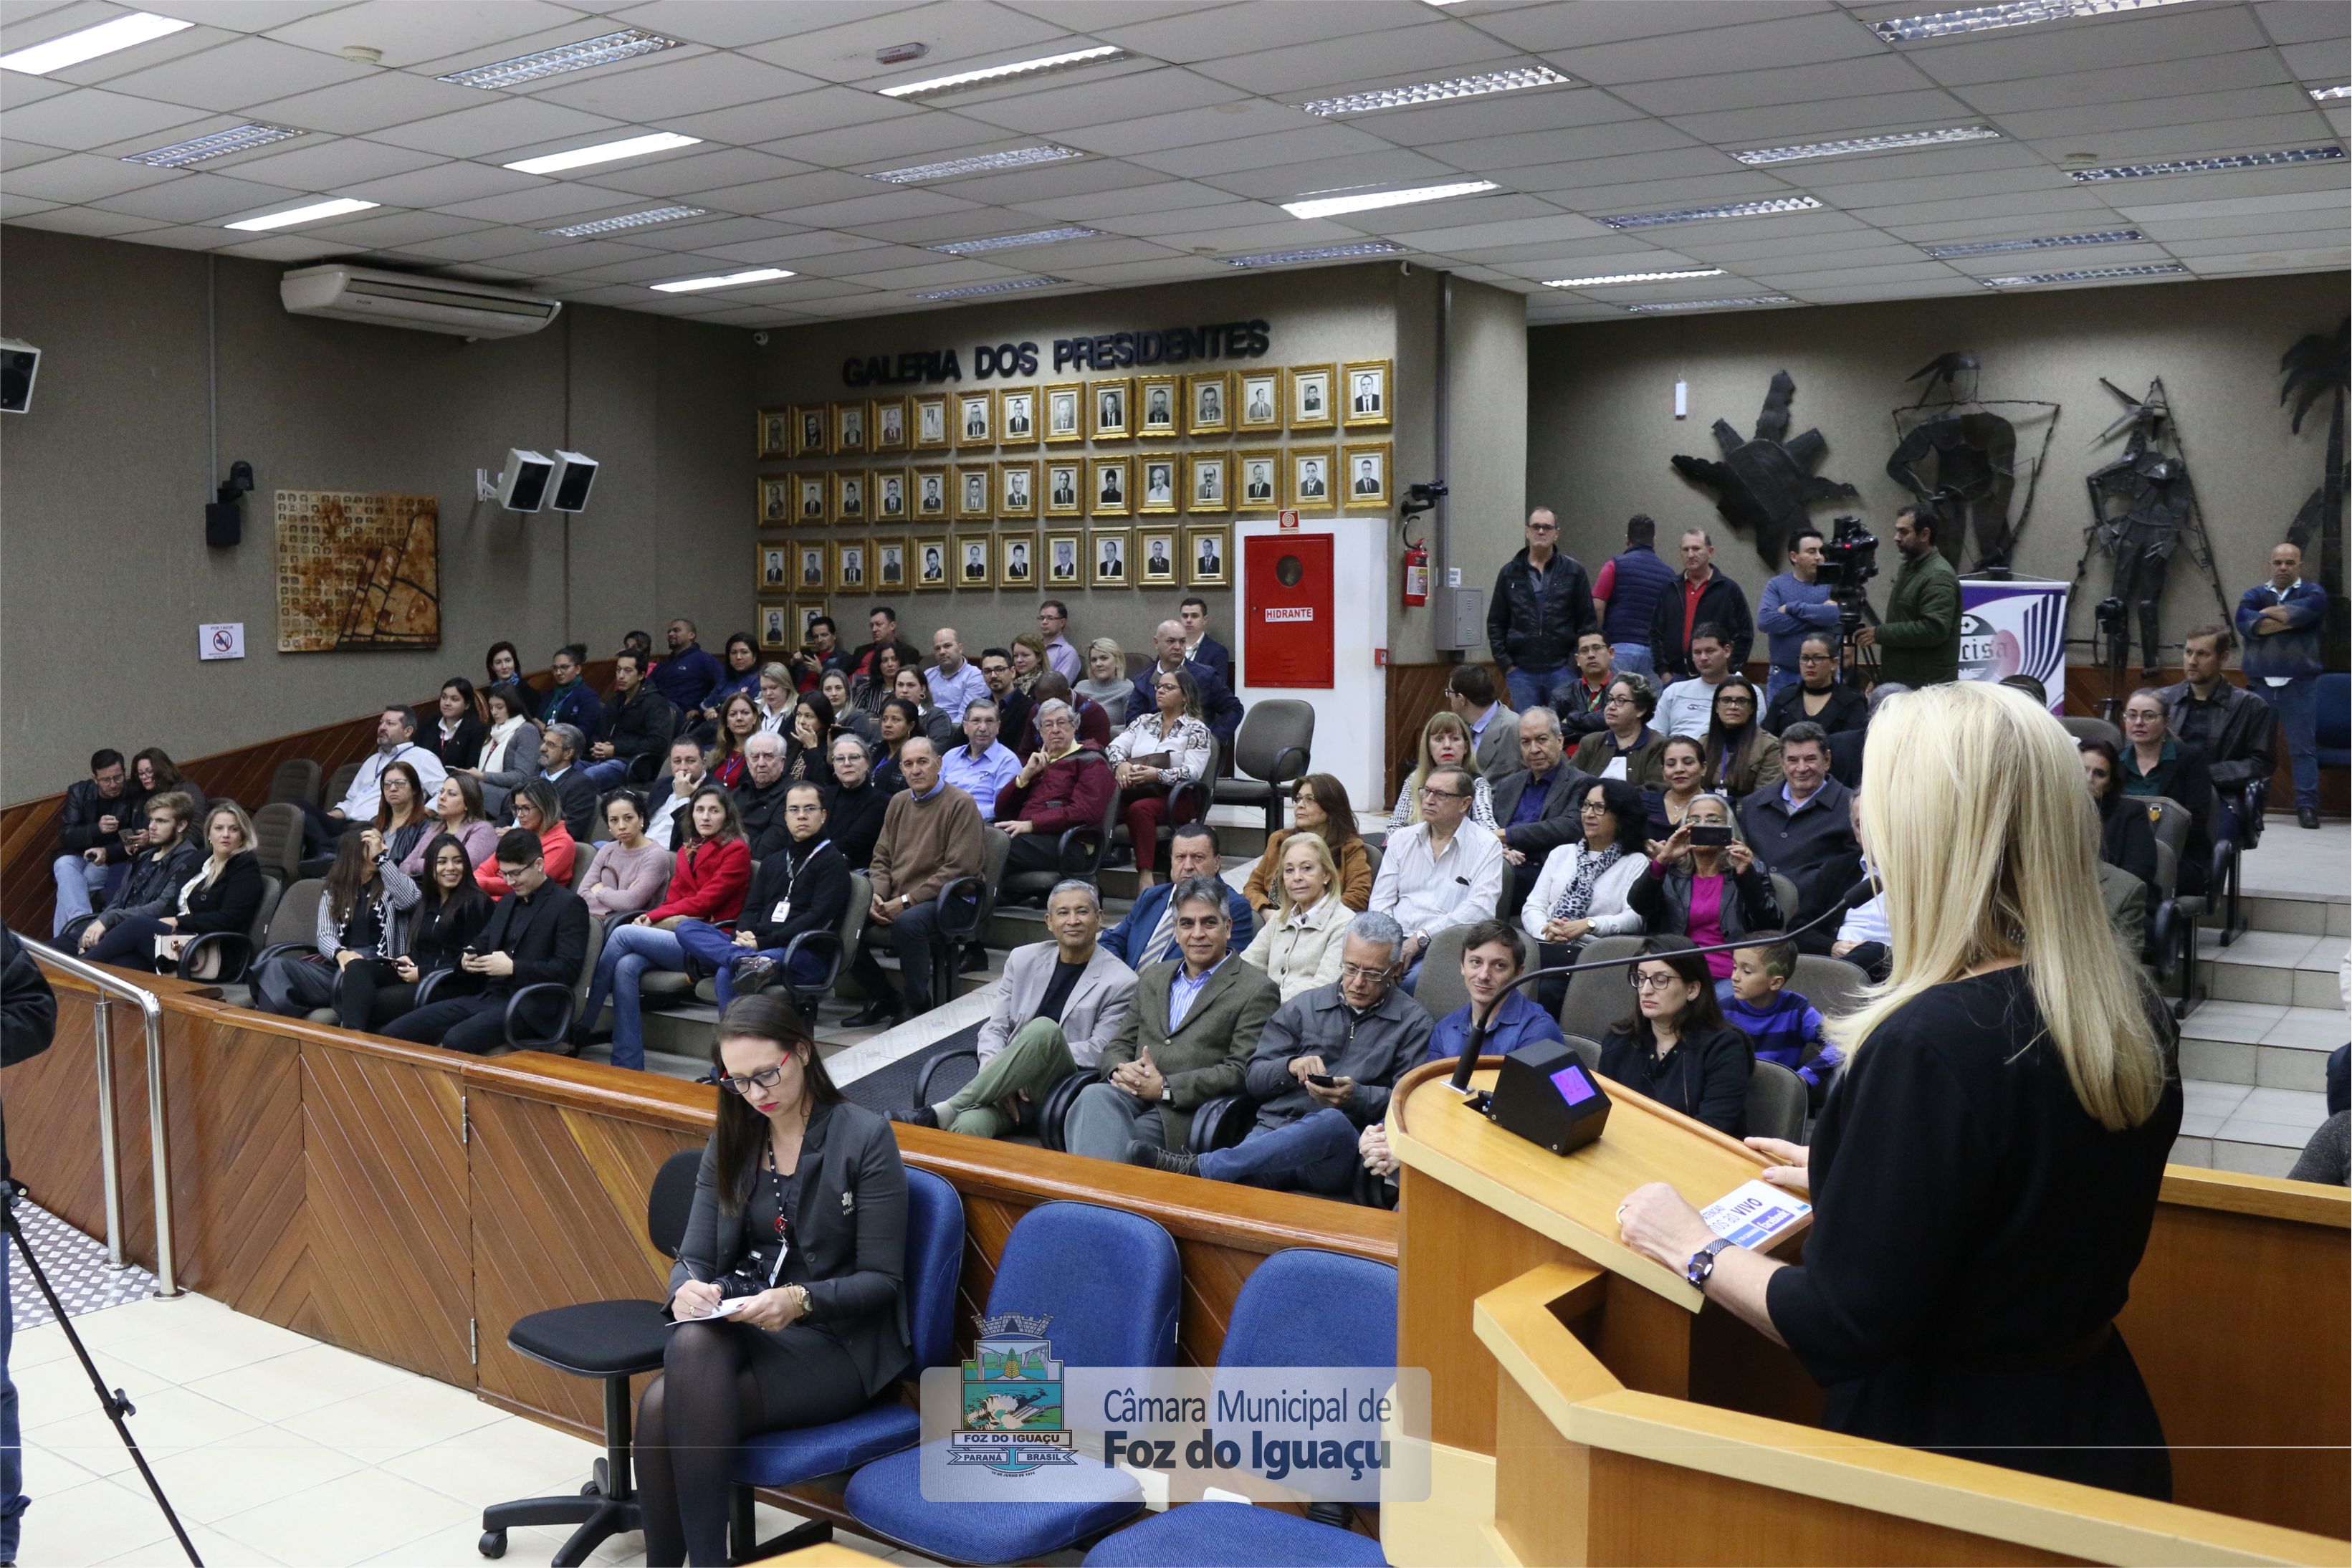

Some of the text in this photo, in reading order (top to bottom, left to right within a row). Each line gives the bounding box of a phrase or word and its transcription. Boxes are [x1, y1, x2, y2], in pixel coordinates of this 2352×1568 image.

[842, 320, 1271, 387] GALERIA DOS PRESIDENTES
[1266, 608, 1311, 618] HIDRANTE
[1730, 1197, 1763, 1216] VIVO
